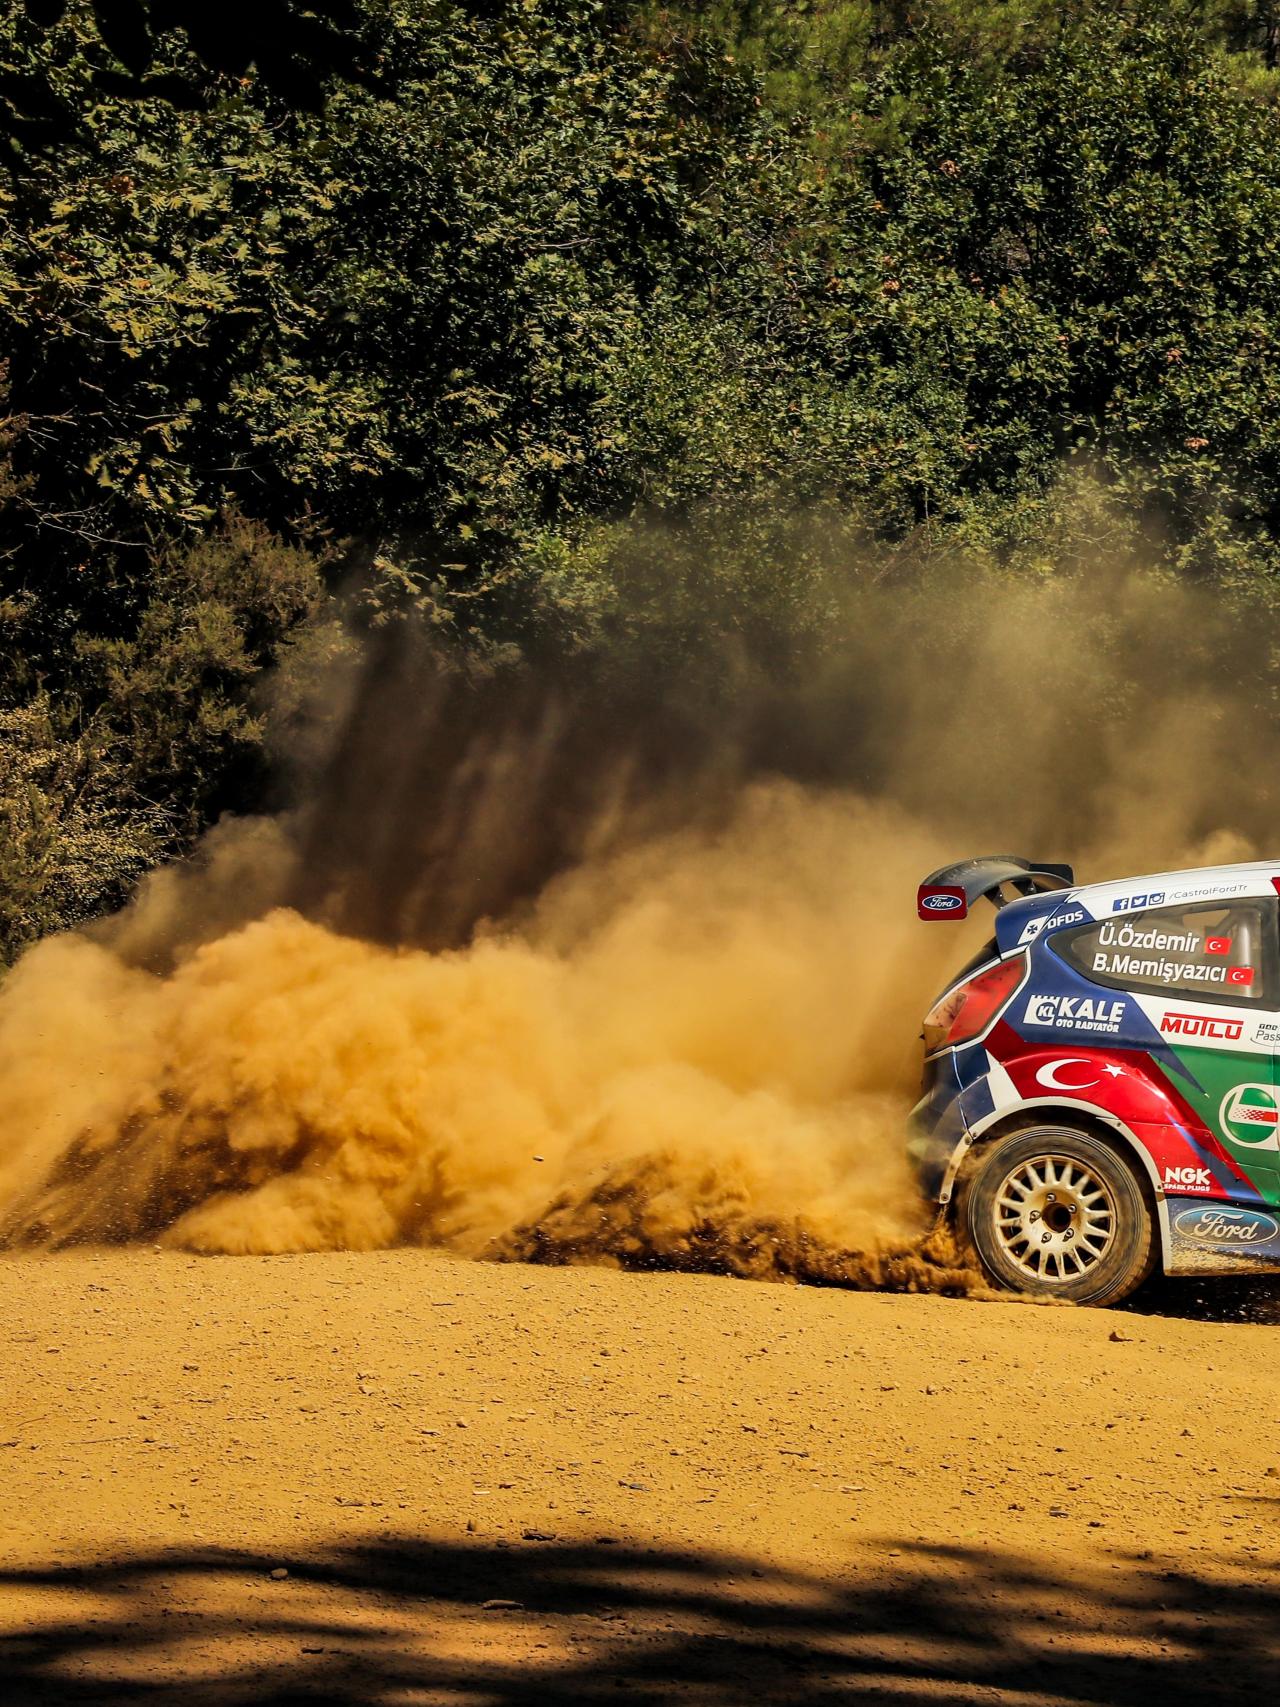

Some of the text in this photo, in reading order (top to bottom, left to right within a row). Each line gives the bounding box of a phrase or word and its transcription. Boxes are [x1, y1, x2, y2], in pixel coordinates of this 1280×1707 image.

[1046, 910, 1084, 930] DFDS
[1099, 922, 1200, 952] Ü.Özdemir
[1092, 953, 1226, 983] B.Memişyazıcı
[1058, 997, 1126, 1022] KALE
[1056, 1019, 1120, 1033] OTO RADYATÖR
[1160, 1012, 1244, 1040] MUTLU
[1164, 1166, 1212, 1185] NGK
[1194, 1210, 1259, 1240] Ford
